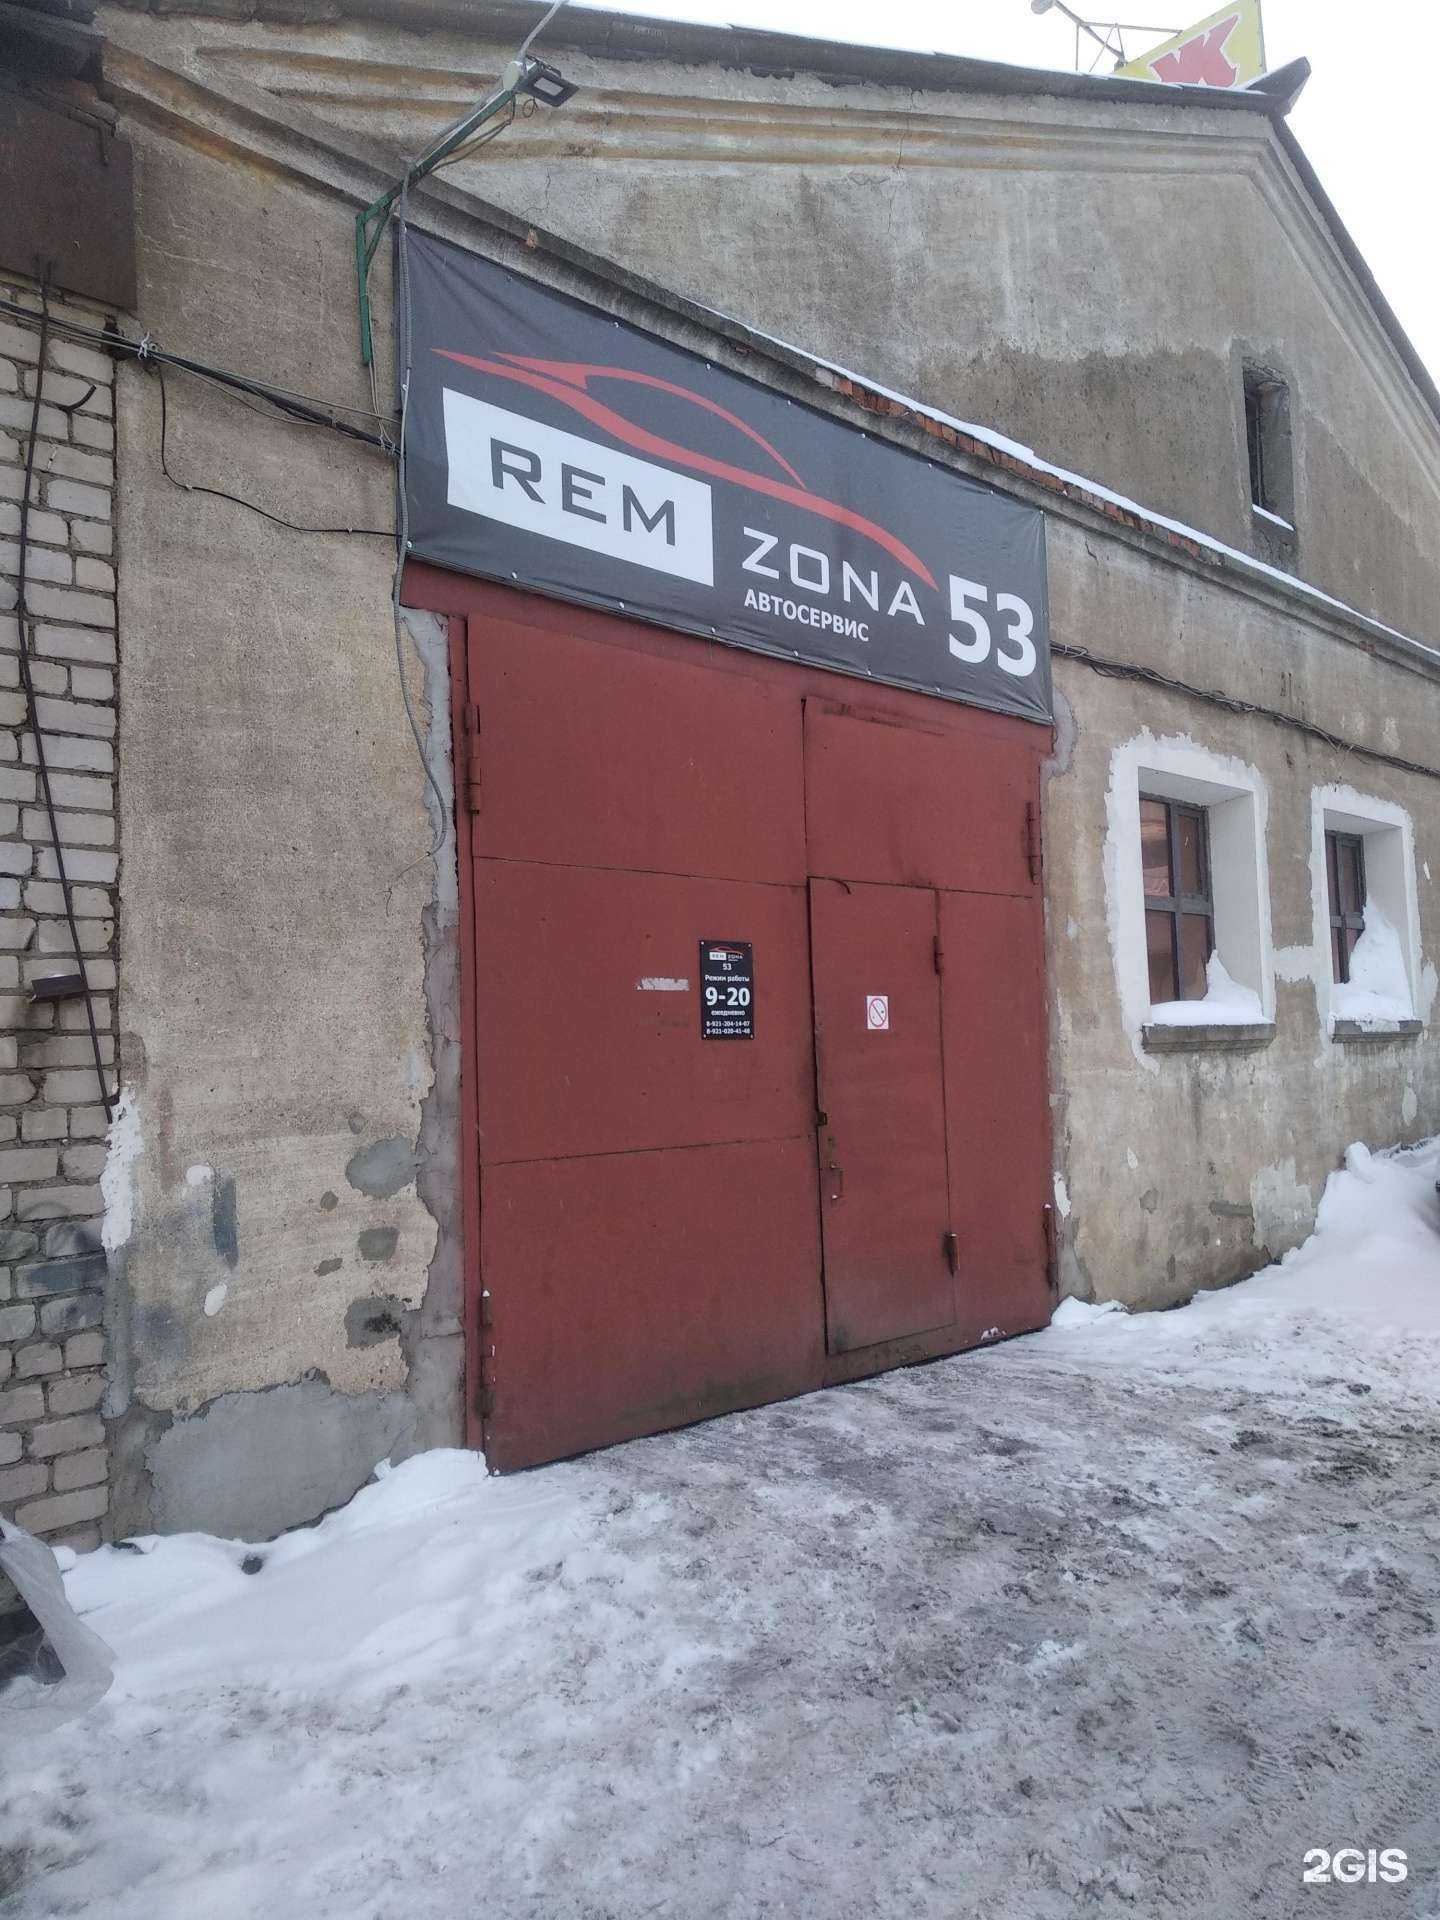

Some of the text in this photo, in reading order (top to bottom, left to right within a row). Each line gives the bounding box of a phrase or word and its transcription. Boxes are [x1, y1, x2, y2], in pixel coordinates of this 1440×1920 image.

[489, 436, 1037, 678] REM ZONA 53
[743, 588, 870, 643] АВТОСЕРВИС
[722, 963, 732, 971] 53
[704, 974, 750, 983] Режим работы
[705, 986, 750, 1006] 9-20
